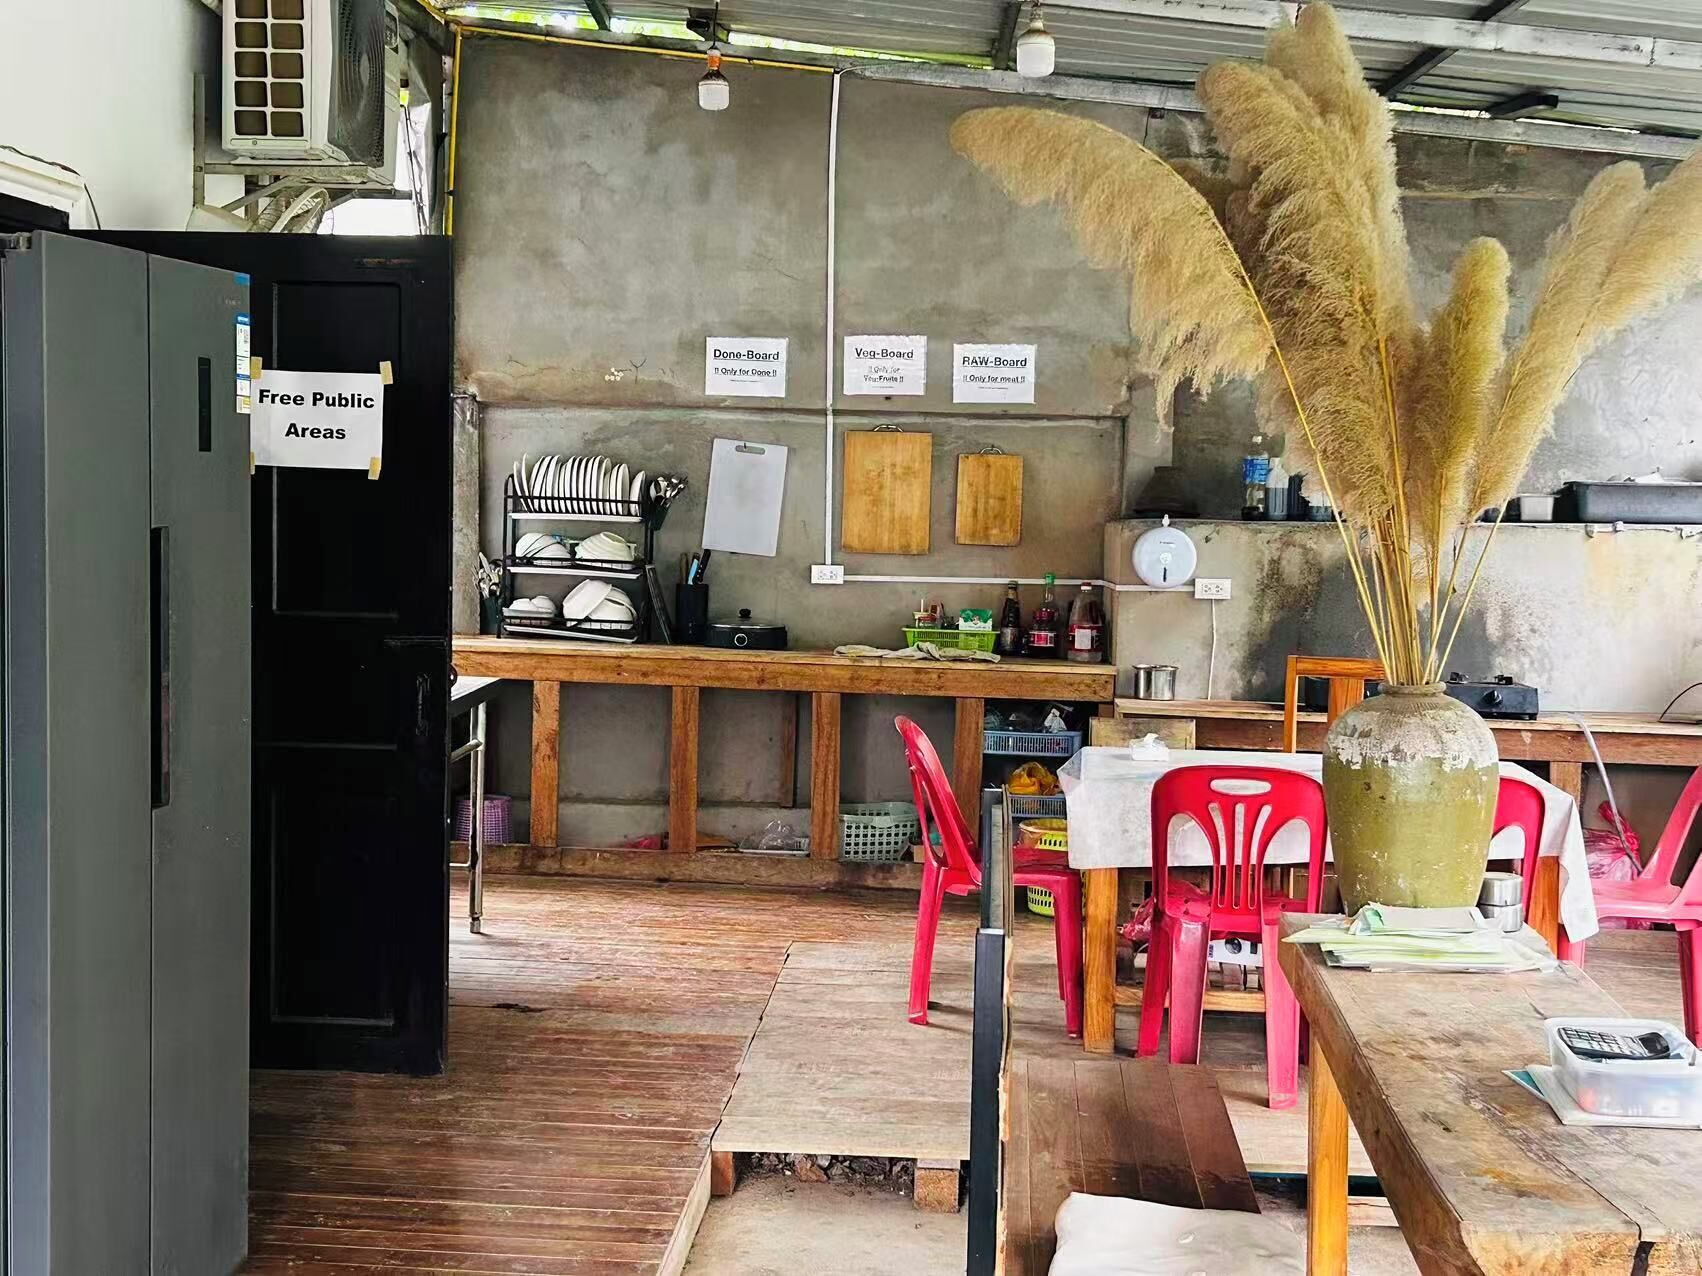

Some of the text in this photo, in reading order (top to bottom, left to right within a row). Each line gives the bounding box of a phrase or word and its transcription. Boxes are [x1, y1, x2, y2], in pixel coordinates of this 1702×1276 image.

[713, 348, 780, 360] Done-Board
[855, 347, 914, 359] Veg-Board
[962, 356, 1027, 367] RAW-Board
[720, 367, 737, 376] Only
[739, 368, 749, 376] for
[751, 368, 771, 376] Done
[969, 374, 986, 383] Only
[987, 375, 998, 383] for
[258, 388, 375, 409] Free Public
[284, 422, 346, 440] Areas
